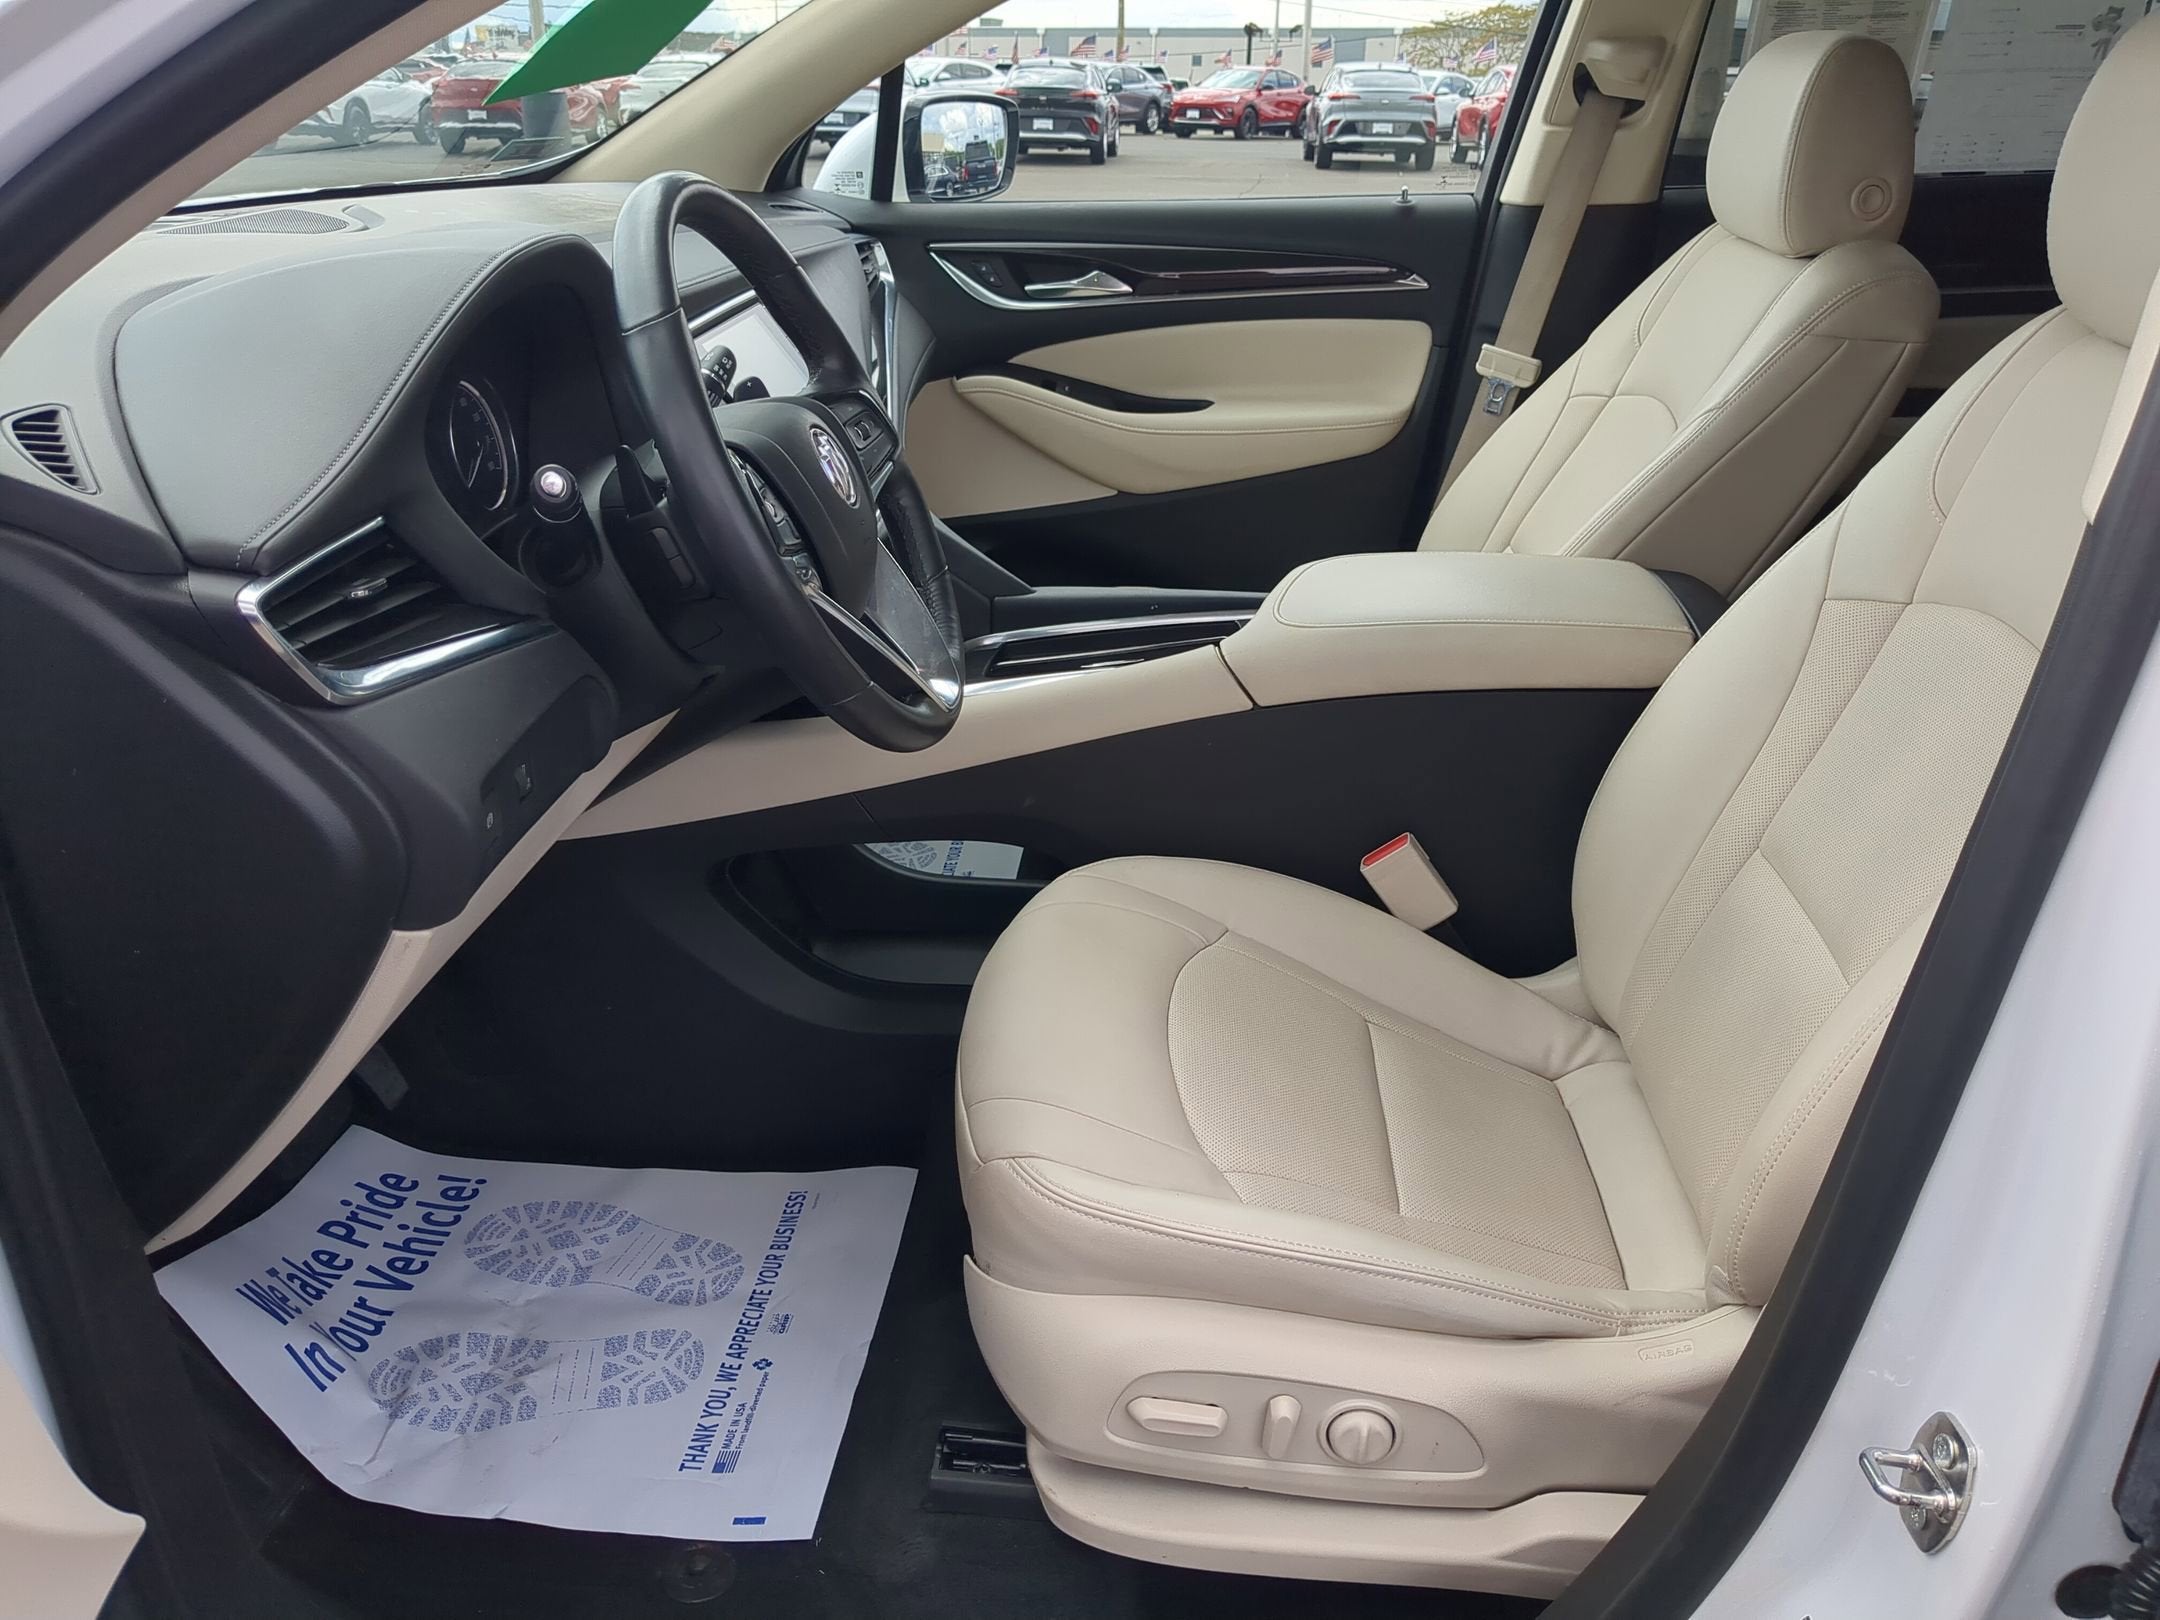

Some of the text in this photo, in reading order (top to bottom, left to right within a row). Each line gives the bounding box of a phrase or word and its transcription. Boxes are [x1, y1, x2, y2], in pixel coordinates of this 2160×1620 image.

[235, 1173, 419, 1326] We Take Pride
[284, 1174, 488, 1392] In Your Vehicle!
[678, 1190, 808, 1472] THANK YOU, WE APPRECIATE YOUR BUSINESS!
[1645, 1344, 1693, 1361] AIRBAG
[721, 1402, 747, 1450] MADE IN USA
[735, 1431, 747, 1450] From
[759, 1371, 770, 1388] paper
